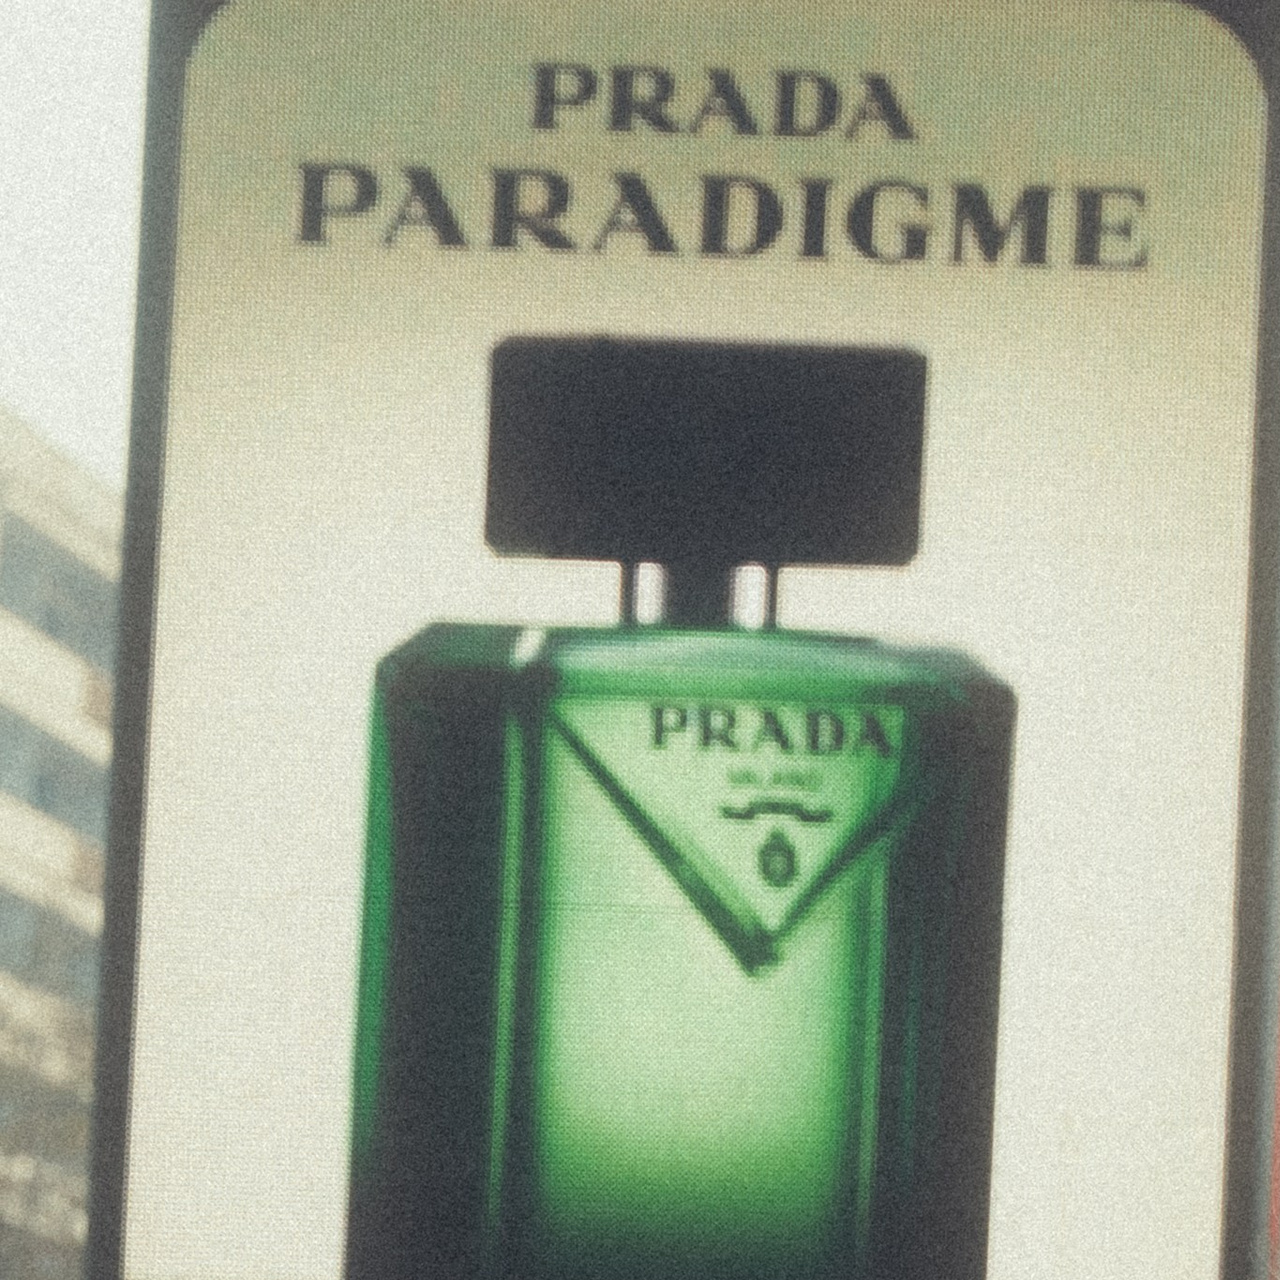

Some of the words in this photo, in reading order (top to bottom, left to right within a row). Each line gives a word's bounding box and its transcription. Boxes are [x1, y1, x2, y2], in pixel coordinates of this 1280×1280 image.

[531, 61, 916, 141] PRADA
[296, 161, 1149, 272] PARADIGME
[653, 704, 893, 758] PRADA
